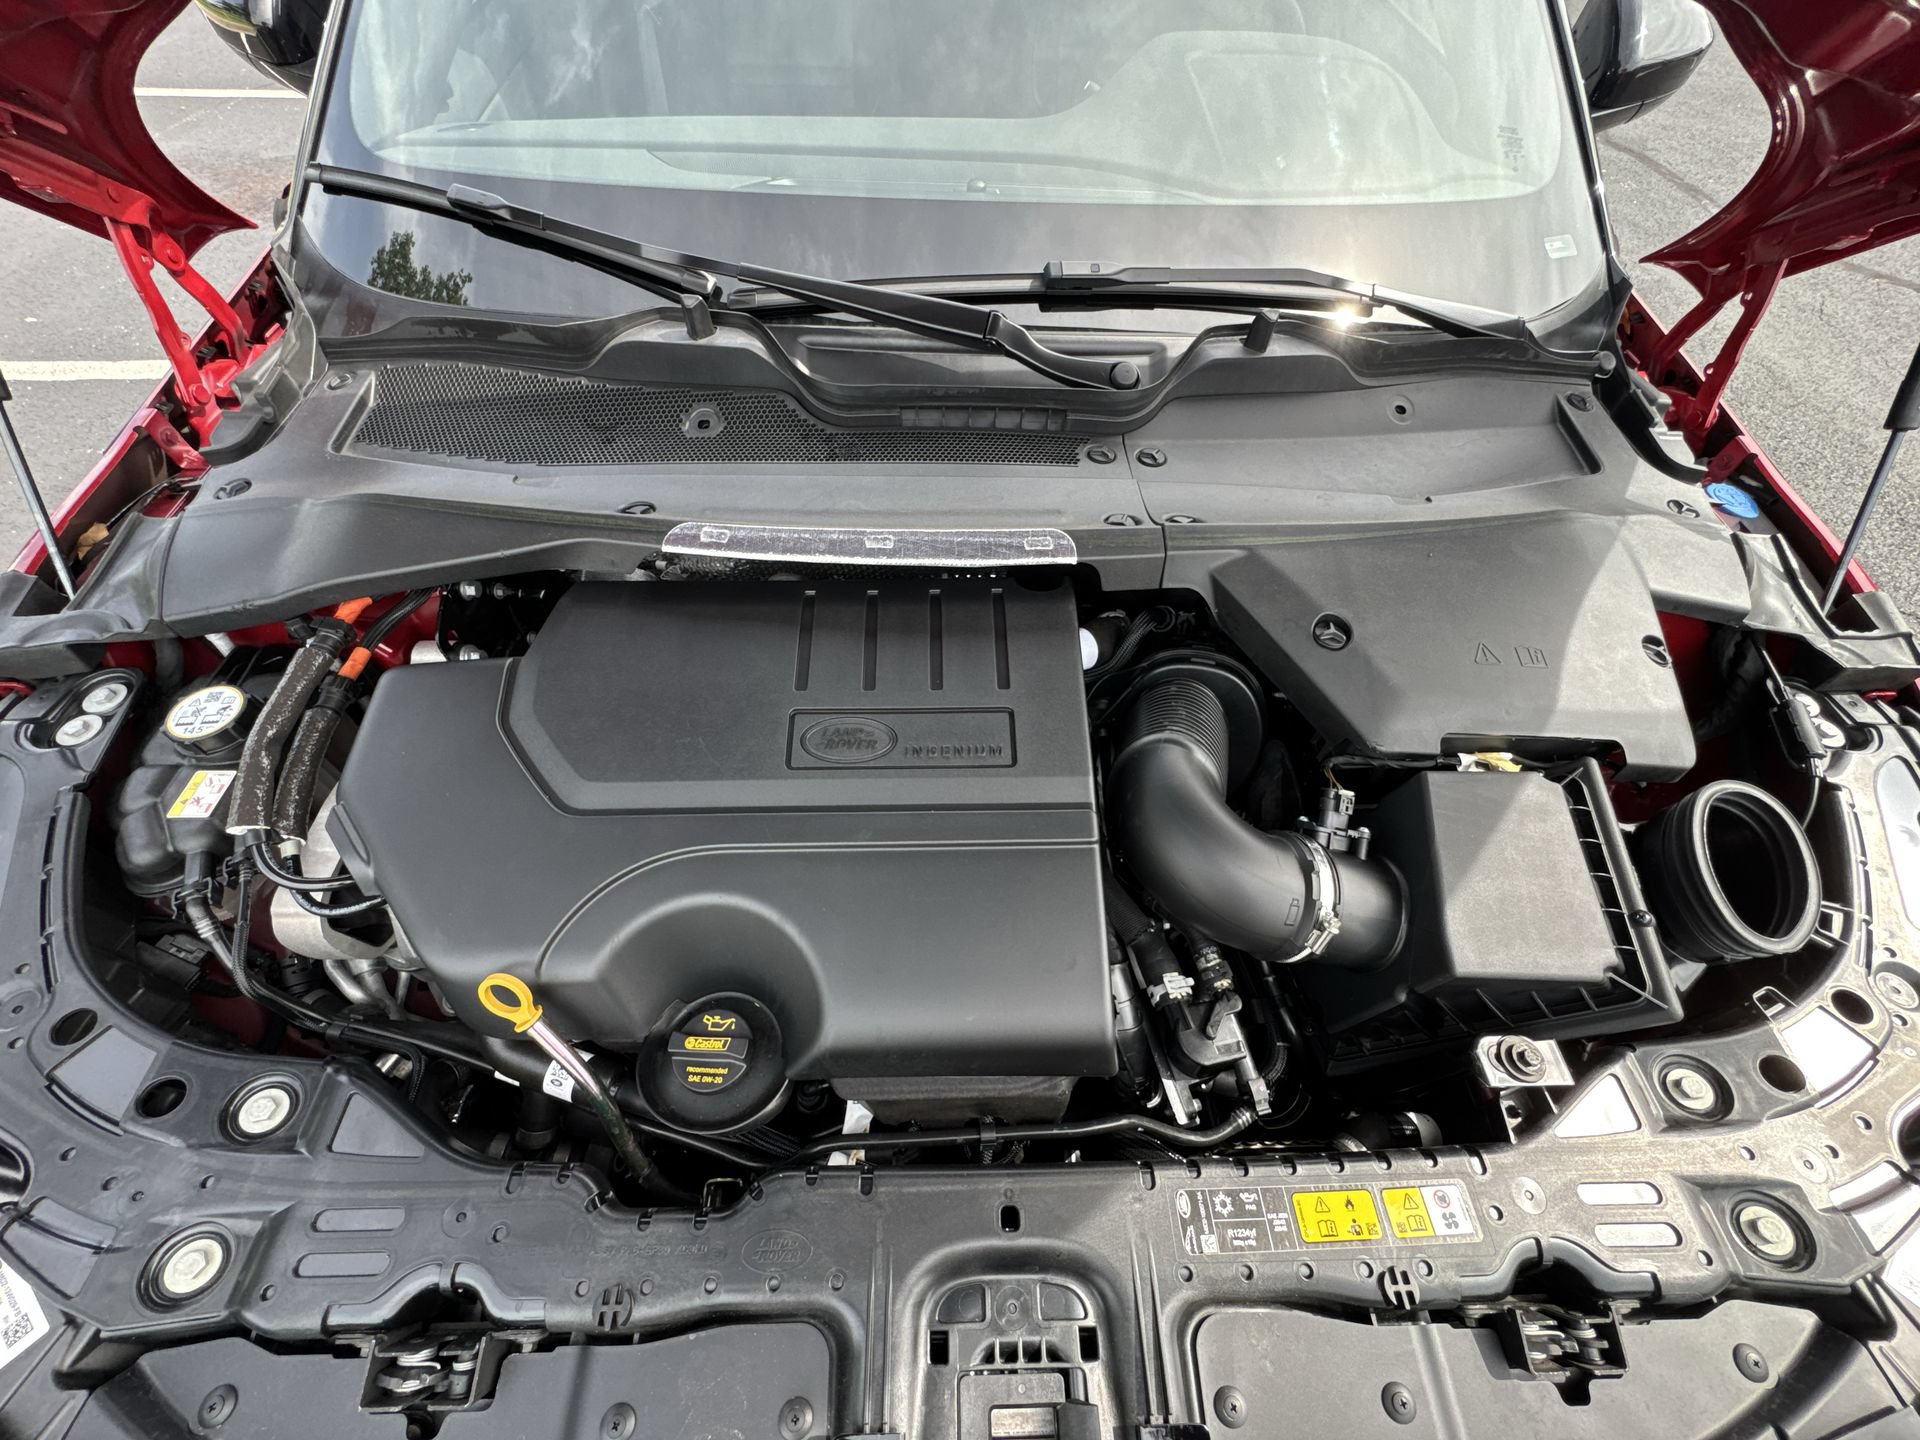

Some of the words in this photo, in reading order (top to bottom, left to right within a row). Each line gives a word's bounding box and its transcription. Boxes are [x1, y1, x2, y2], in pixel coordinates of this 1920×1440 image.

[821, 727, 867, 738] LAND
[822, 739, 878, 750] ROVER
[904, 744, 1003, 759] INGENIUM
[695, 1039, 724, 1049] Castrol
[686, 1066, 728, 1074] recommended
[687, 1075, 701, 1083] SAE
